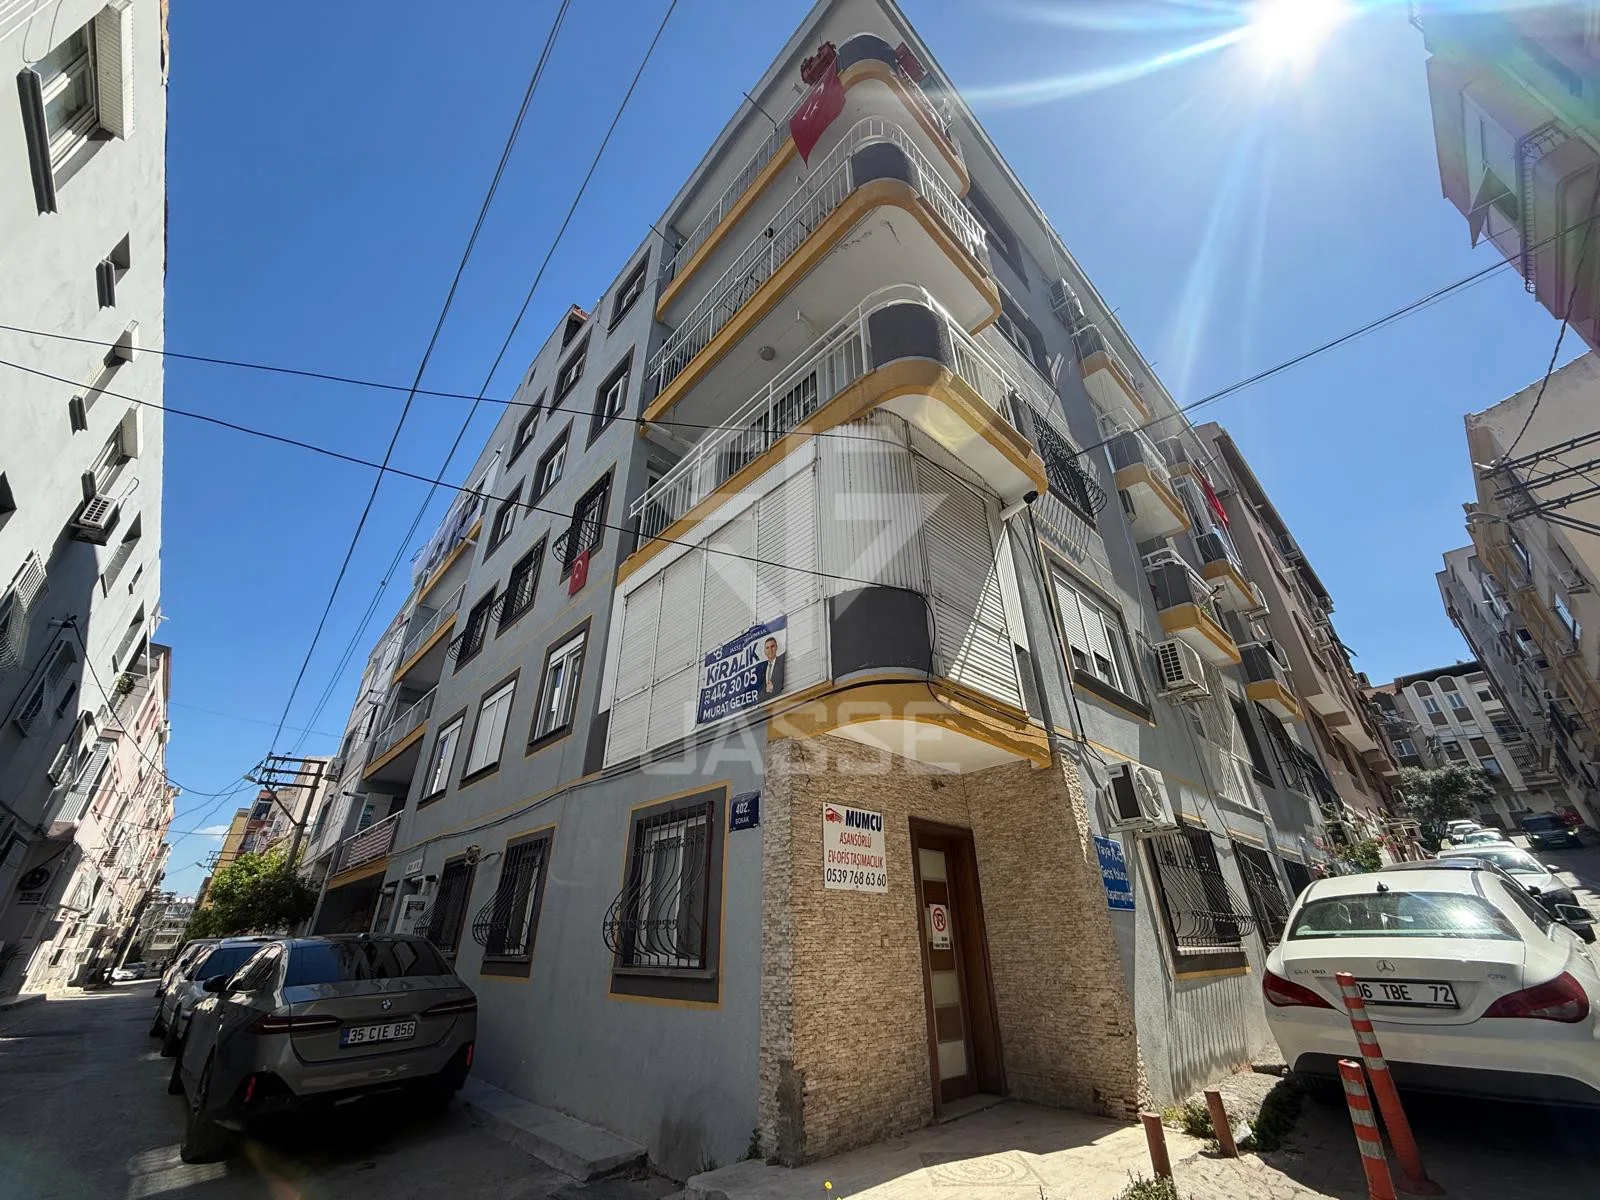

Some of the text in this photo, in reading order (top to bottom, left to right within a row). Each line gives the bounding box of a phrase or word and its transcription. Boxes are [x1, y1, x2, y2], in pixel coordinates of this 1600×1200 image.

[706, 642, 760, 686] KİRALIK
[711, 667, 758, 702] 442 30 05
[703, 690, 759, 720] MURAT GEZER
[845, 809, 882, 832] MUMCU
[840, 832, 872, 848] ASANSÖRLÜ
[826, 868, 886, 887] 0539 768 63 60
[1380, 984, 1412, 1000] TBE
[1427, 985, 1454, 1003] 72
[350, 1022, 414, 1042] 35 CIE 856
